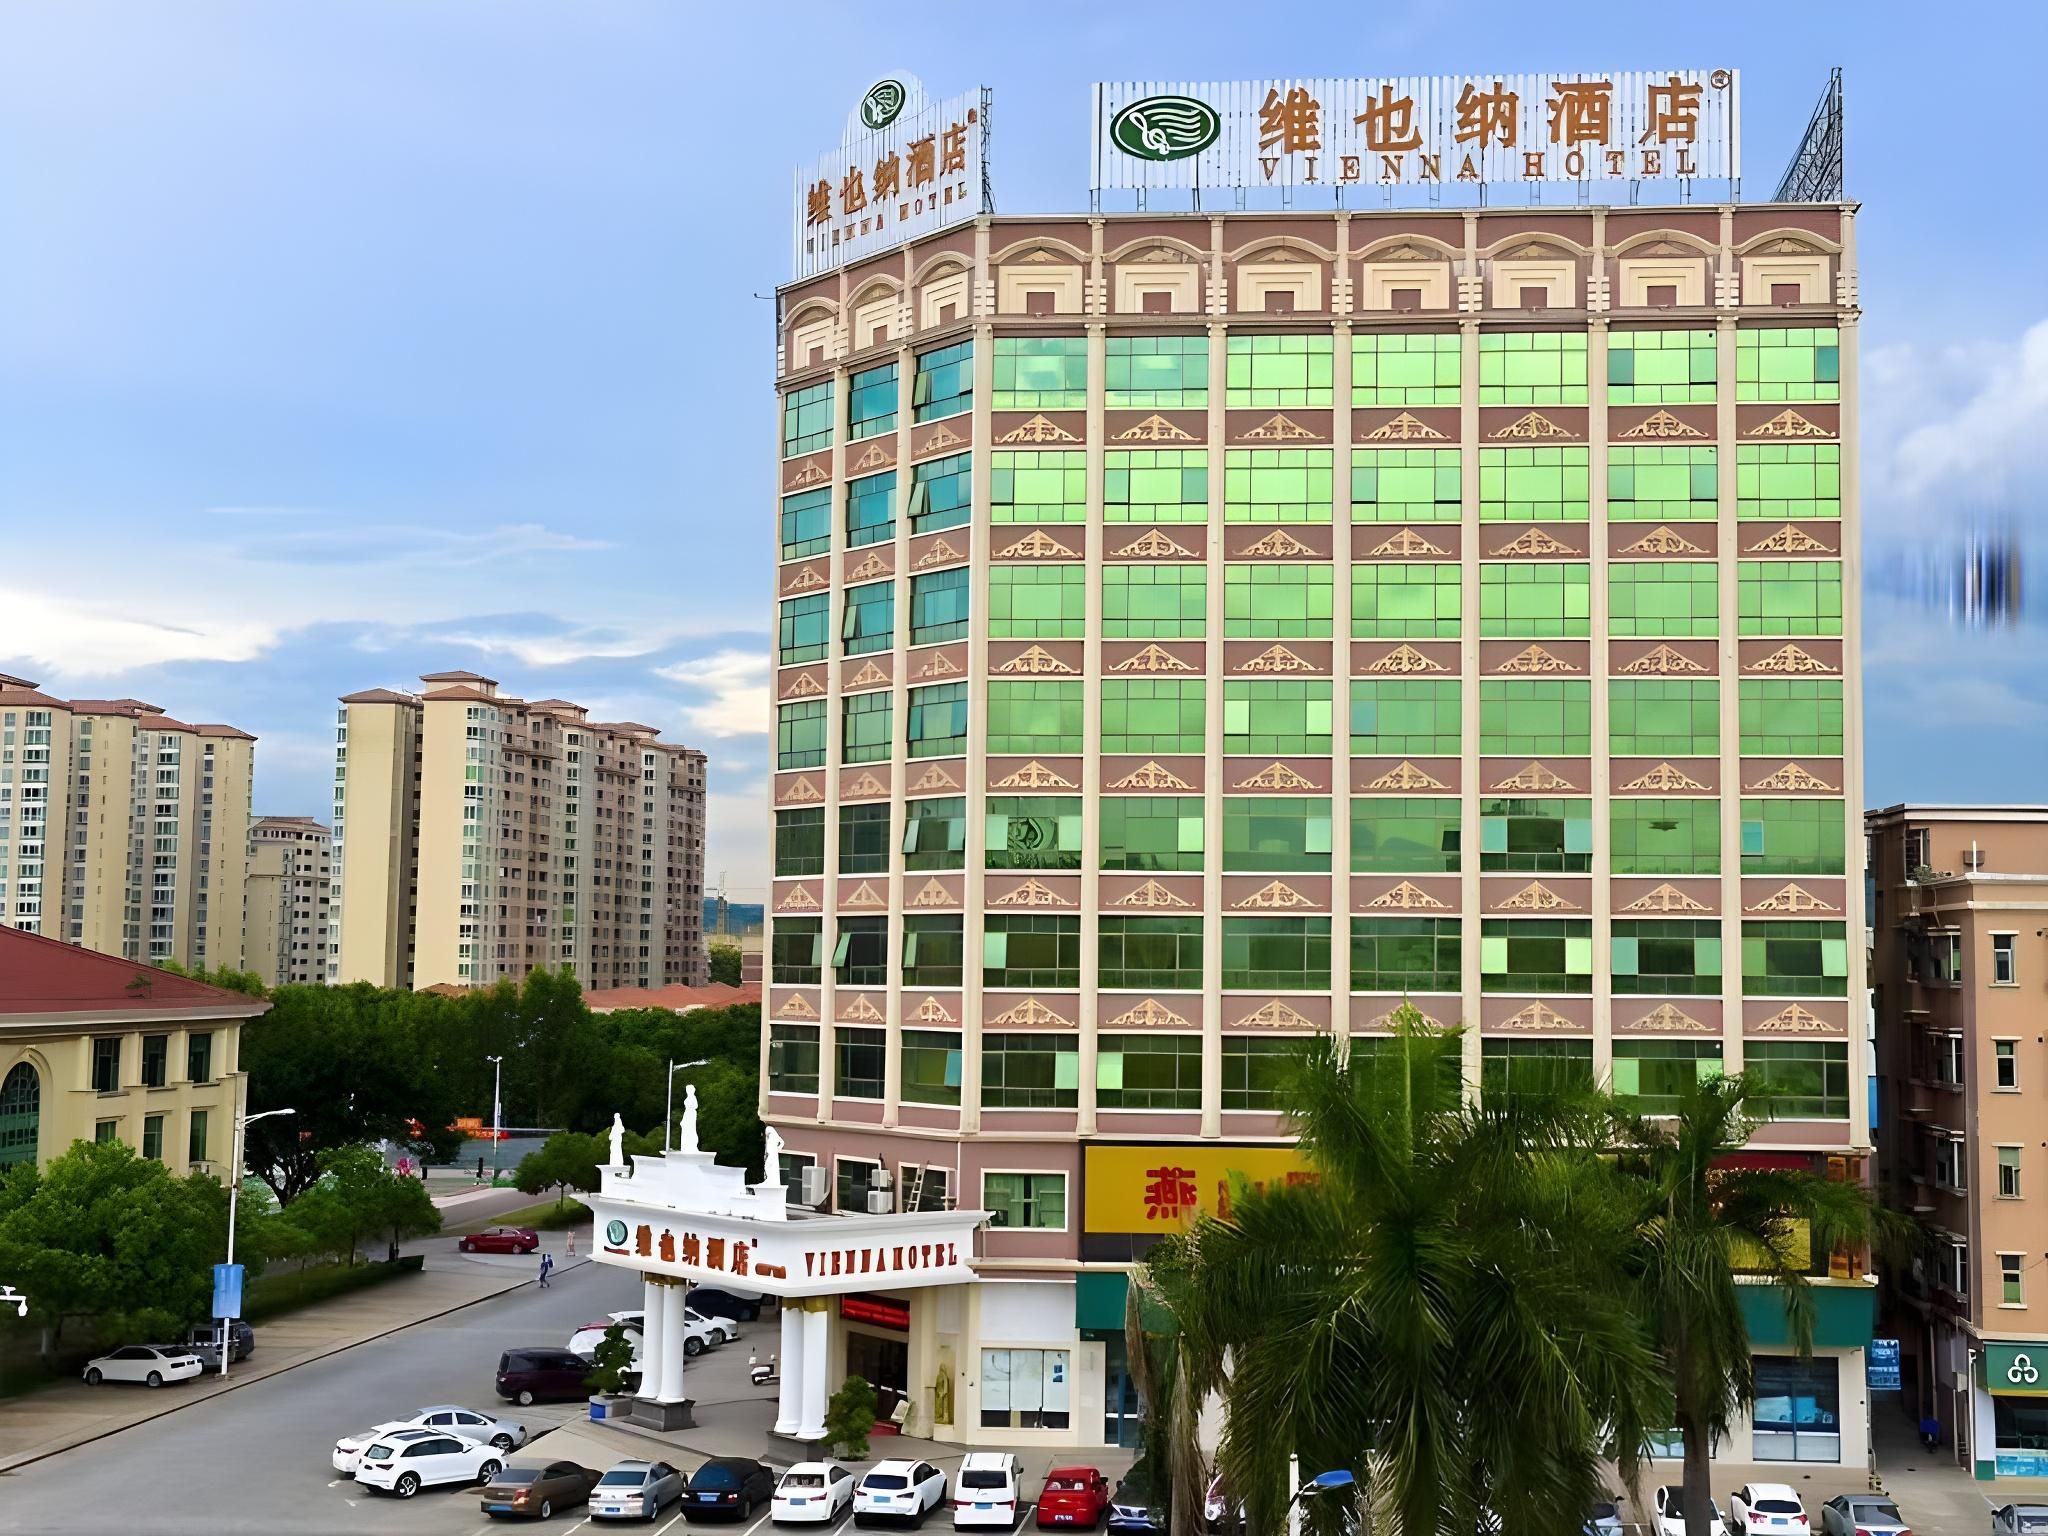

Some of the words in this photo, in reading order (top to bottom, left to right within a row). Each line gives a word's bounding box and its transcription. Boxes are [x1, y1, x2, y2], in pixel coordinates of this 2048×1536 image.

[1258, 77, 1704, 155] 维也纳酒店
[1258, 153, 1481, 184] VIENNA
[1522, 149, 1697, 177] HOTEL
